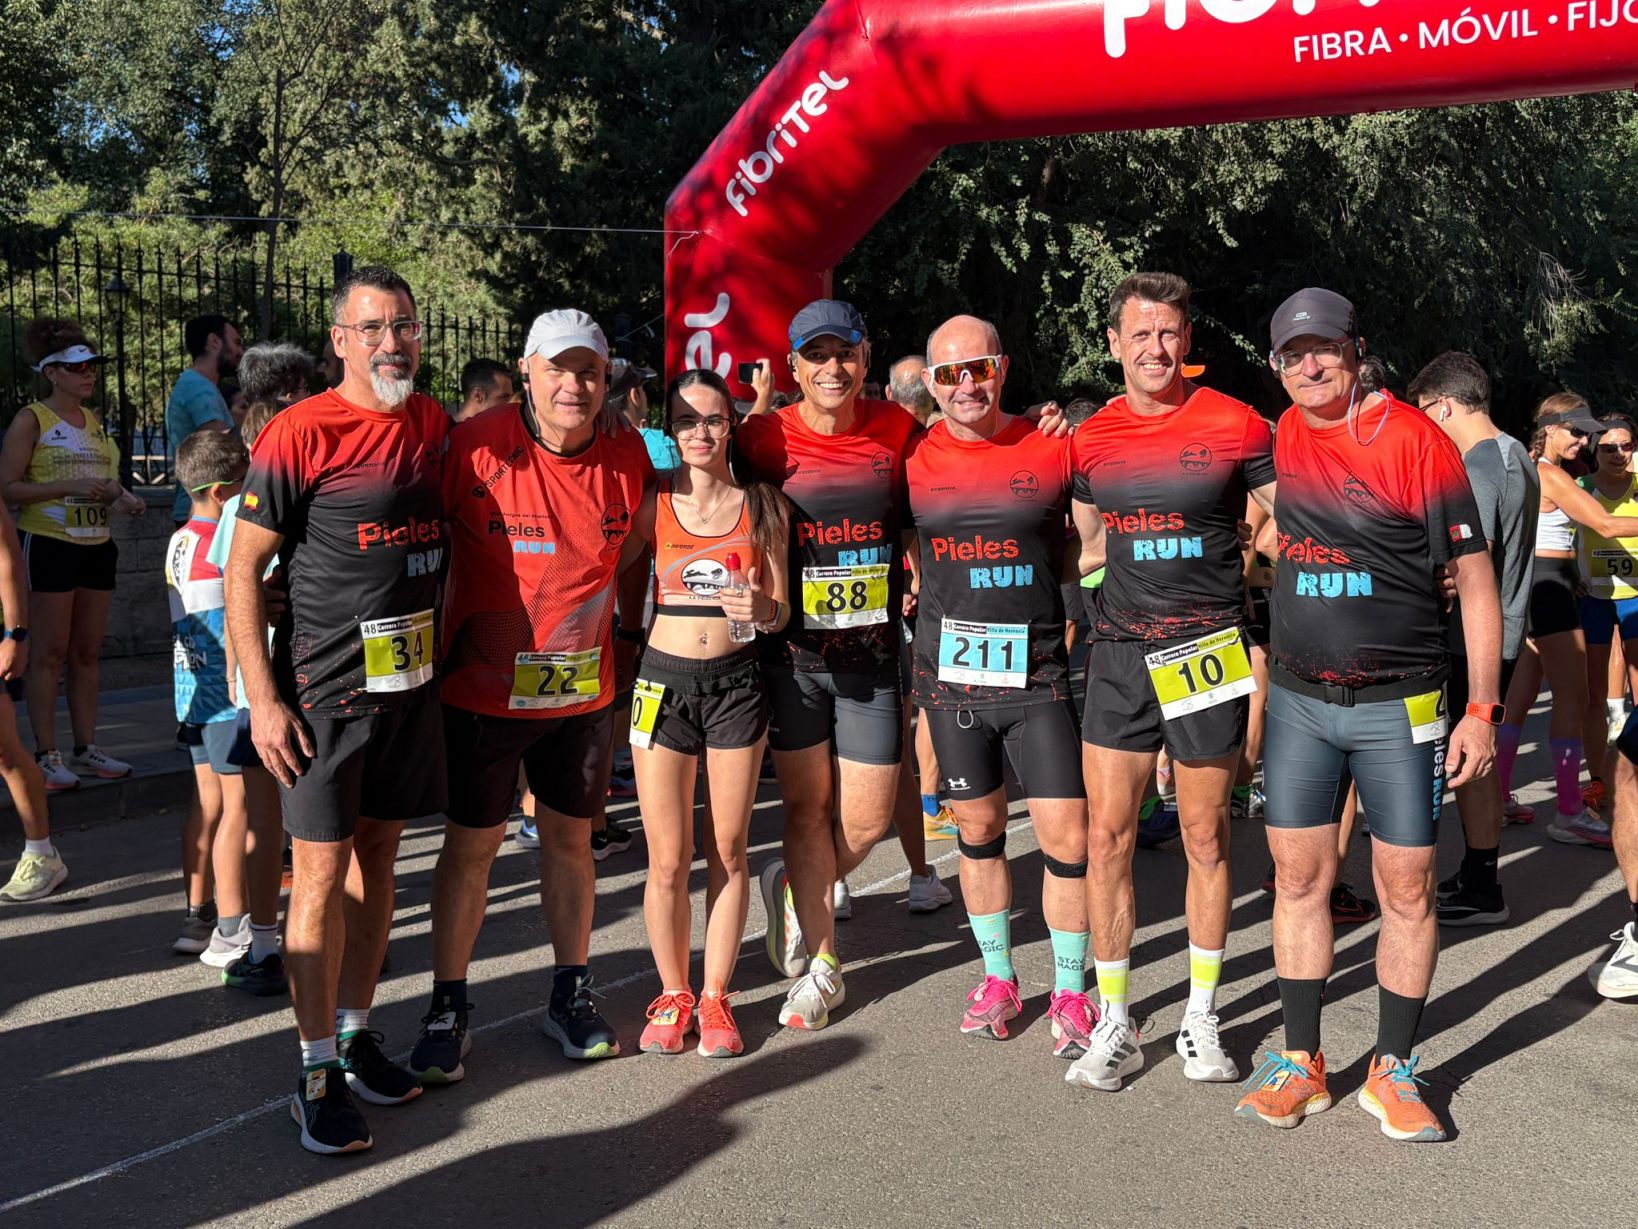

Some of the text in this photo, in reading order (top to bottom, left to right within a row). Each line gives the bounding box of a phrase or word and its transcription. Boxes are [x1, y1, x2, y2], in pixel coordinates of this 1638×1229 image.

[1293, 27, 1392, 62] FIBRA
[1419, 7, 1538, 48] MÓVIL
[74, 507, 107, 526] 109
[488, 519, 545, 538] Pieles
[1101, 508, 1185, 535] Pieles
[357, 517, 440, 550] Pieles
[797, 518, 883, 547] Pieles
[513, 541, 556, 555] RUN
[838, 544, 893, 567] RUN
[931, 535, 1020, 561] Pieles
[1133, 537, 1203, 561] RUN
[407, 547, 443, 578] RU
[1607, 558, 1633, 576] 59
[970, 565, 1033, 589] RUN
[1296, 571, 1373, 598] RUN
[827, 581, 867, 612] 88
[364, 623, 377, 634] 48
[943, 621, 953, 631] 48
[392, 629, 424, 671] 34
[953, 636, 1013, 670] 211
[537, 665, 578, 696] 22
[1178, 653, 1224, 694] 10
[1433, 778, 1443, 820] RUN
